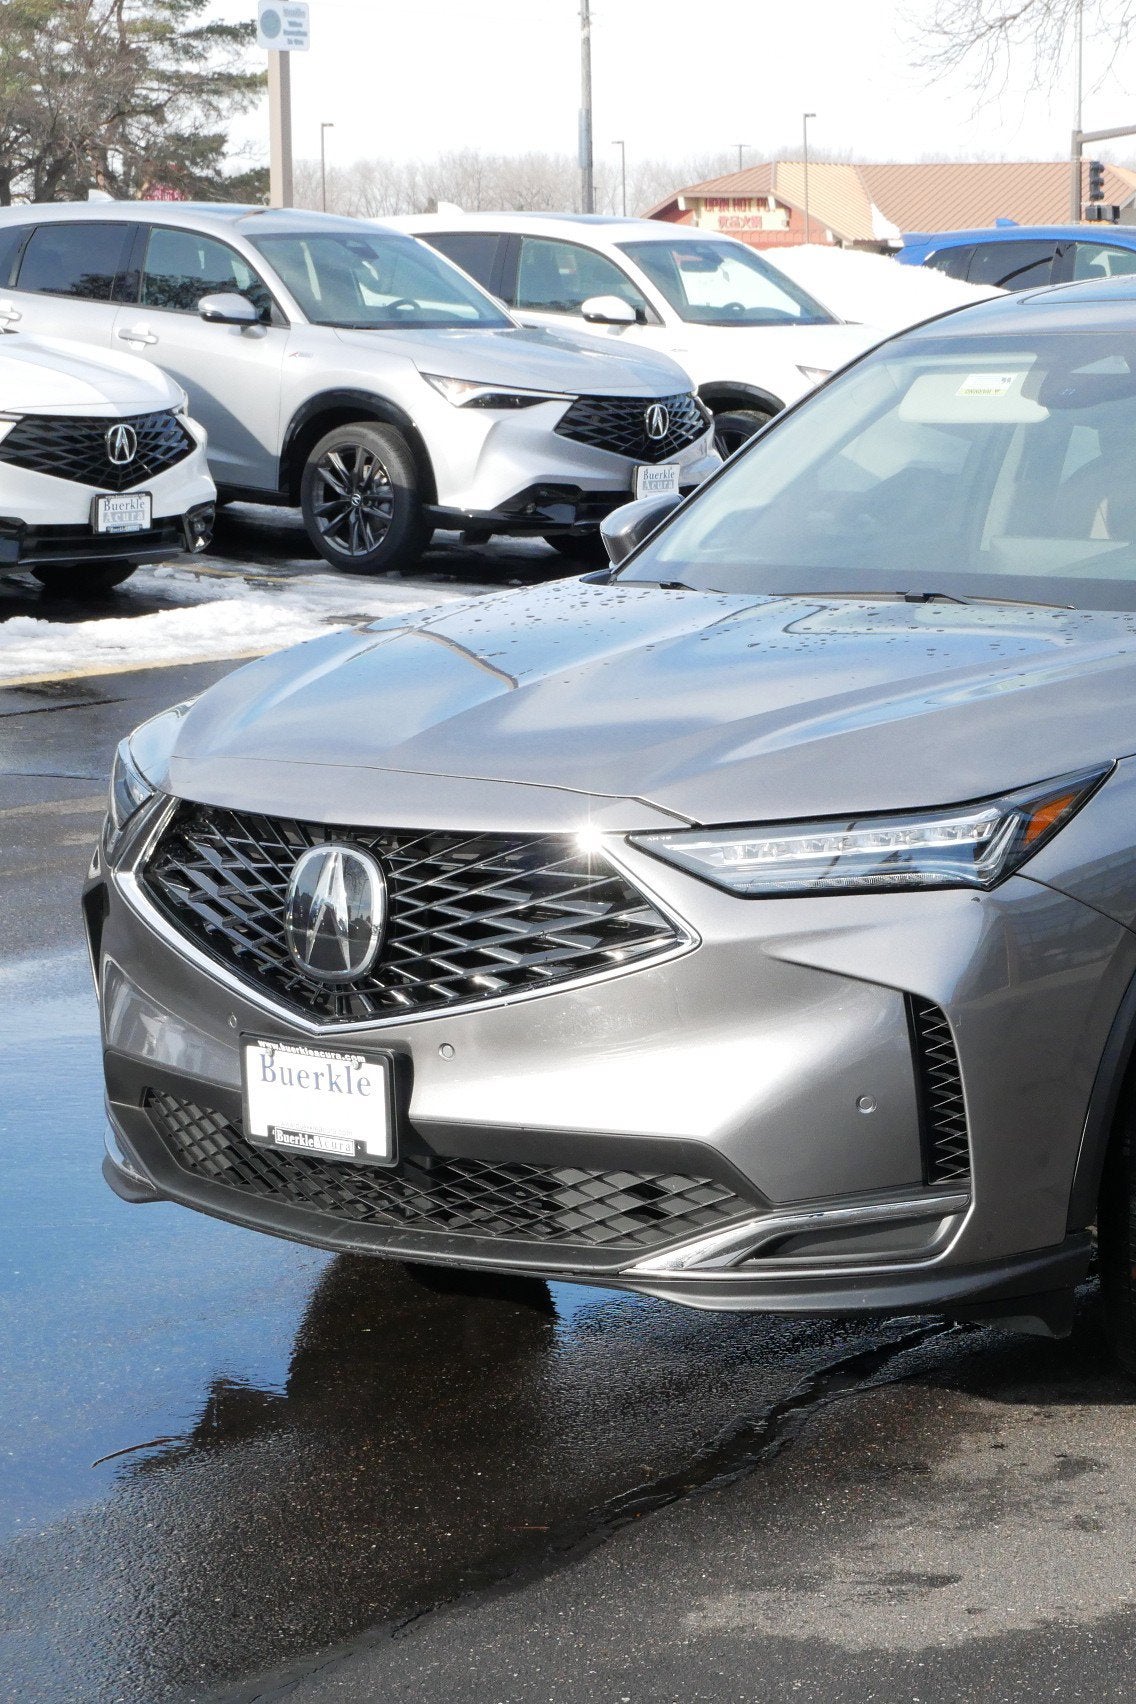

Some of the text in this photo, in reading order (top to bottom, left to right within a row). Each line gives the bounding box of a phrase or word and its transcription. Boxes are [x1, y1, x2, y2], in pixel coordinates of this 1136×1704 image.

[733, 198, 753, 212] HOT
[643, 469, 675, 480] Buerkle
[643, 480, 675, 490] Acura
[103, 499, 145, 511] Buerkle
[104, 510, 145, 523] Acura
[259, 1053, 371, 1097] Buerkle
